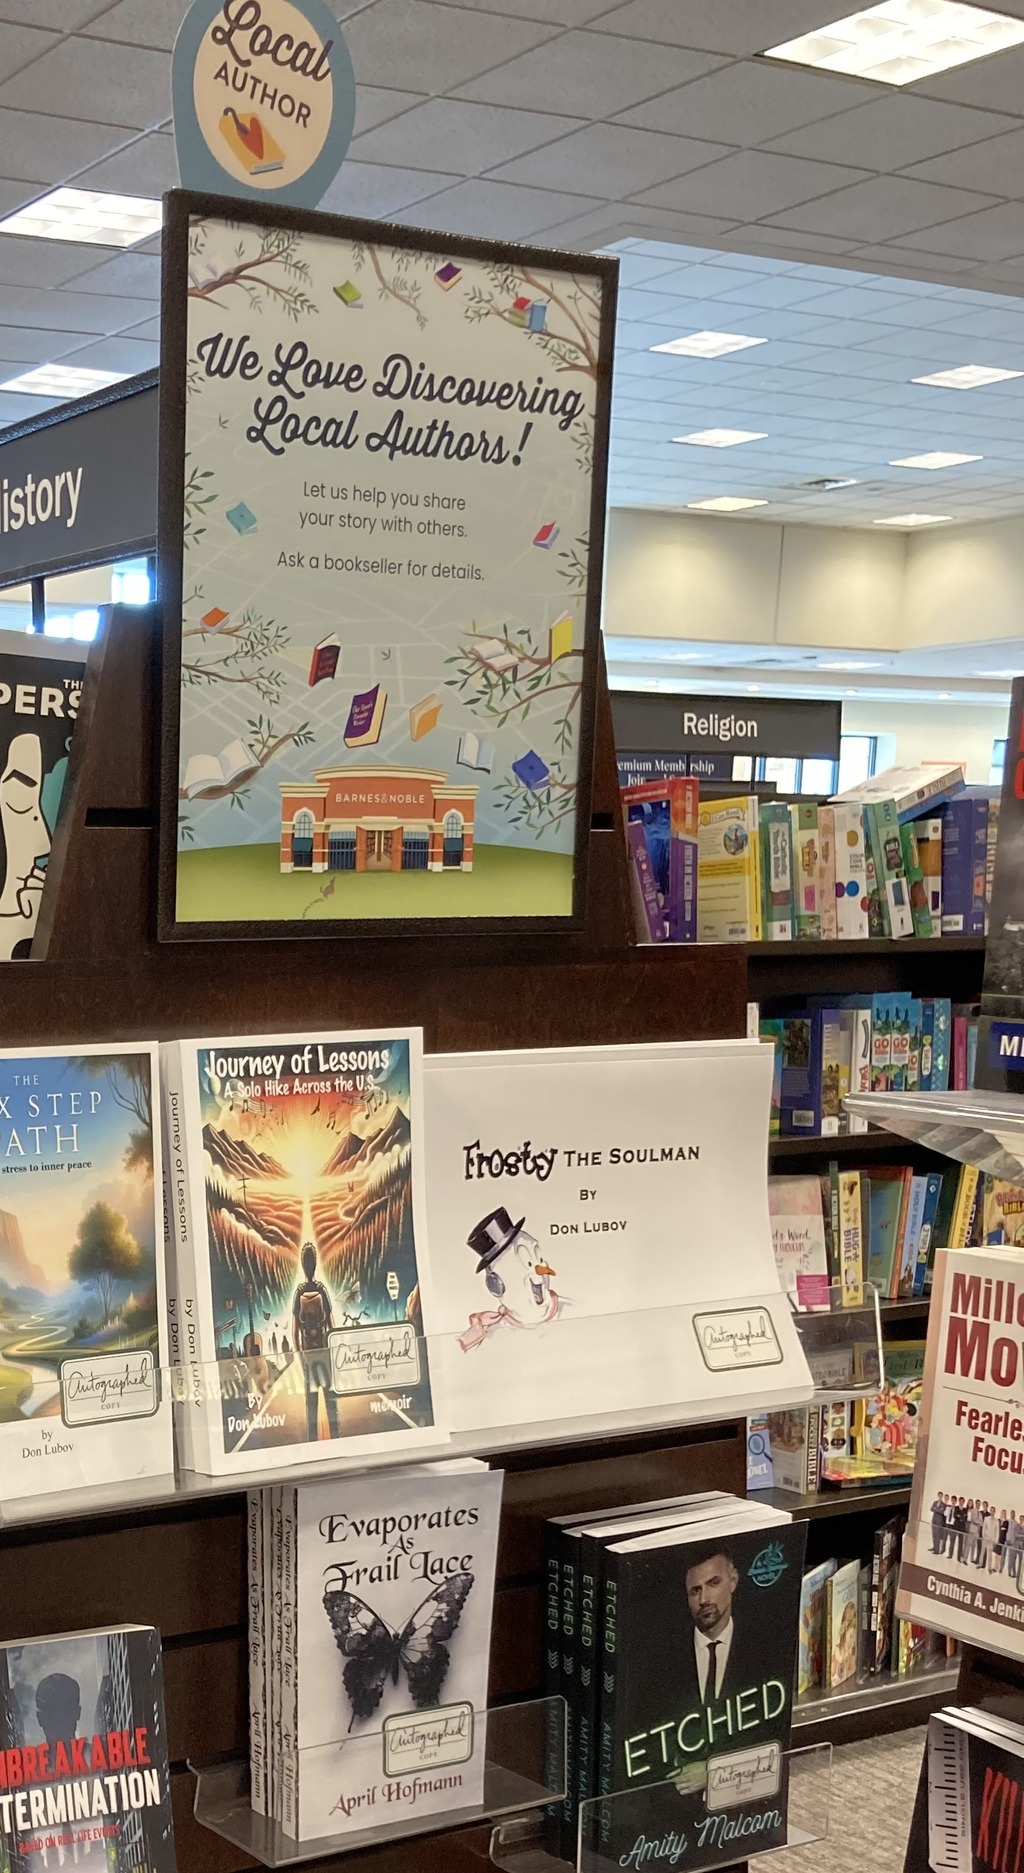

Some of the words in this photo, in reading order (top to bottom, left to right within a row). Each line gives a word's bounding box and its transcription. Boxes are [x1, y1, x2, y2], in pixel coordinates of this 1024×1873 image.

[211, 0, 334, 82] Local
[213, 60, 312, 129] AUTHOR
[196, 332, 263, 380] We
[267, 341, 367, 399] Love
[372, 353, 585, 431] Discovering
[246, 395, 359, 456] Local
[365, 409, 534, 466] Authors!
[303, 481, 326, 499] Let
[330, 486, 349, 500] us
[353, 485, 387, 508] help
[391, 491, 419, 509] you
[423, 492, 466, 511] share
[299, 511, 335, 529] your
[338, 512, 377, 534] story
[381, 516, 412, 533] with
[417, 519, 468, 538] others.
[277, 551, 305, 568] Ask
[309, 556, 319, 569] a
[324, 553, 403, 575] bookseller
[407, 559, 427, 576] for
[431, 562, 485, 581] details.
[683, 712, 758, 742] Religion
[654, 759, 715, 775] Membrship
[874, 1037, 889, 1049] GO
[893, 1037, 908, 1049] GO
[204, 1050, 285, 1079] Journey
[291, 1045, 313, 1075] of
[317, 1044, 391, 1073] Lessons
[13, 1075, 39, 1086] THE
[224, 1085, 233, 1098] A
[237, 1081, 262, 1098] Solo
[265, 1080, 290, 1097] Hike
[292, 1078, 332, 1095] Across
[334, 1076, 354, 1092] the
[28, 1091, 102, 1118] STEP
[169, 1091, 181, 1153] Journey
[2, 1165, 27, 1174] stress
[29, 1163, 39, 1172] to
[41, 1162, 65, 1172] inner
[67, 1161, 92, 1172] peace
[175, 1158, 184, 1174] of
[463, 1139, 558, 1181] Frosty
[177, 1179, 188, 1243] Lessons
[843, 1229, 851, 1262] BIBLE
[168, 1299, 177, 1317] by
[185, 1299, 194, 1317] by
[170, 1323, 180, 1353] Don
[187, 1323, 196, 1354] Don
[703, 1316, 774, 1351] Autographed
[335, 1331, 416, 1374] Autographed
[67, 1357, 152, 1402] Autographed
[190, 1360, 202, 1407] Lubov
[101, 1402, 121, 1411] COPY
[247, 1392, 263, 1409] By
[370, 1394, 413, 1413] memoir
[41, 1430, 53, 1442] by
[228, 1416, 249, 1432] Don
[252, 1413, 286, 1429] Lubov
[22, 1447, 42, 1459] Don
[45, 1441, 74, 1456] Lubov
[971, 1437, 1024, 1475] Focu
[808, 1451, 817, 1485] BIBLE
[249, 1498, 259, 1571] Evaporates
[318, 1506, 479, 1547] Evaporates
[283, 1515, 292, 1590] Evaporates
[387, 1534, 415, 1555] As
[250, 1574, 259, 1593] As
[323, 1554, 403, 1593] Frail
[409, 1550, 474, 1585] Lace
[284, 1594, 292, 1613] As
[547, 1560, 559, 1630] ETCHED
[563, 1564, 574, 1636] ETCHED
[582, 1574, 594, 1647] ETCHED
[926, 1574, 972, 1607] Cynthia
[973, 1591, 986, 1609] A.
[989, 1596, 1024, 1624] Jenki
[604, 1580, 617, 1654] ETCHED
[251, 1702, 261, 1737] April
[390, 1710, 467, 1753] Autographed
[624, 1680, 786, 1778] ETCHED
[602, 1721, 612, 1772] AMITY
[253, 1741, 262, 1798] Hofmann
[711, 1749, 776, 1790] Autographed
[283, 1764, 294, 1823] Hofmann
[329, 1786, 378, 1816] April
[382, 1774, 463, 1804] Hofmann
[46, 1837, 56, 1849] ON
[77, 1828, 92, 1842] LIFE
[619, 1831, 688, 1871] Amity
[694, 1810, 782, 1849] Malcom
